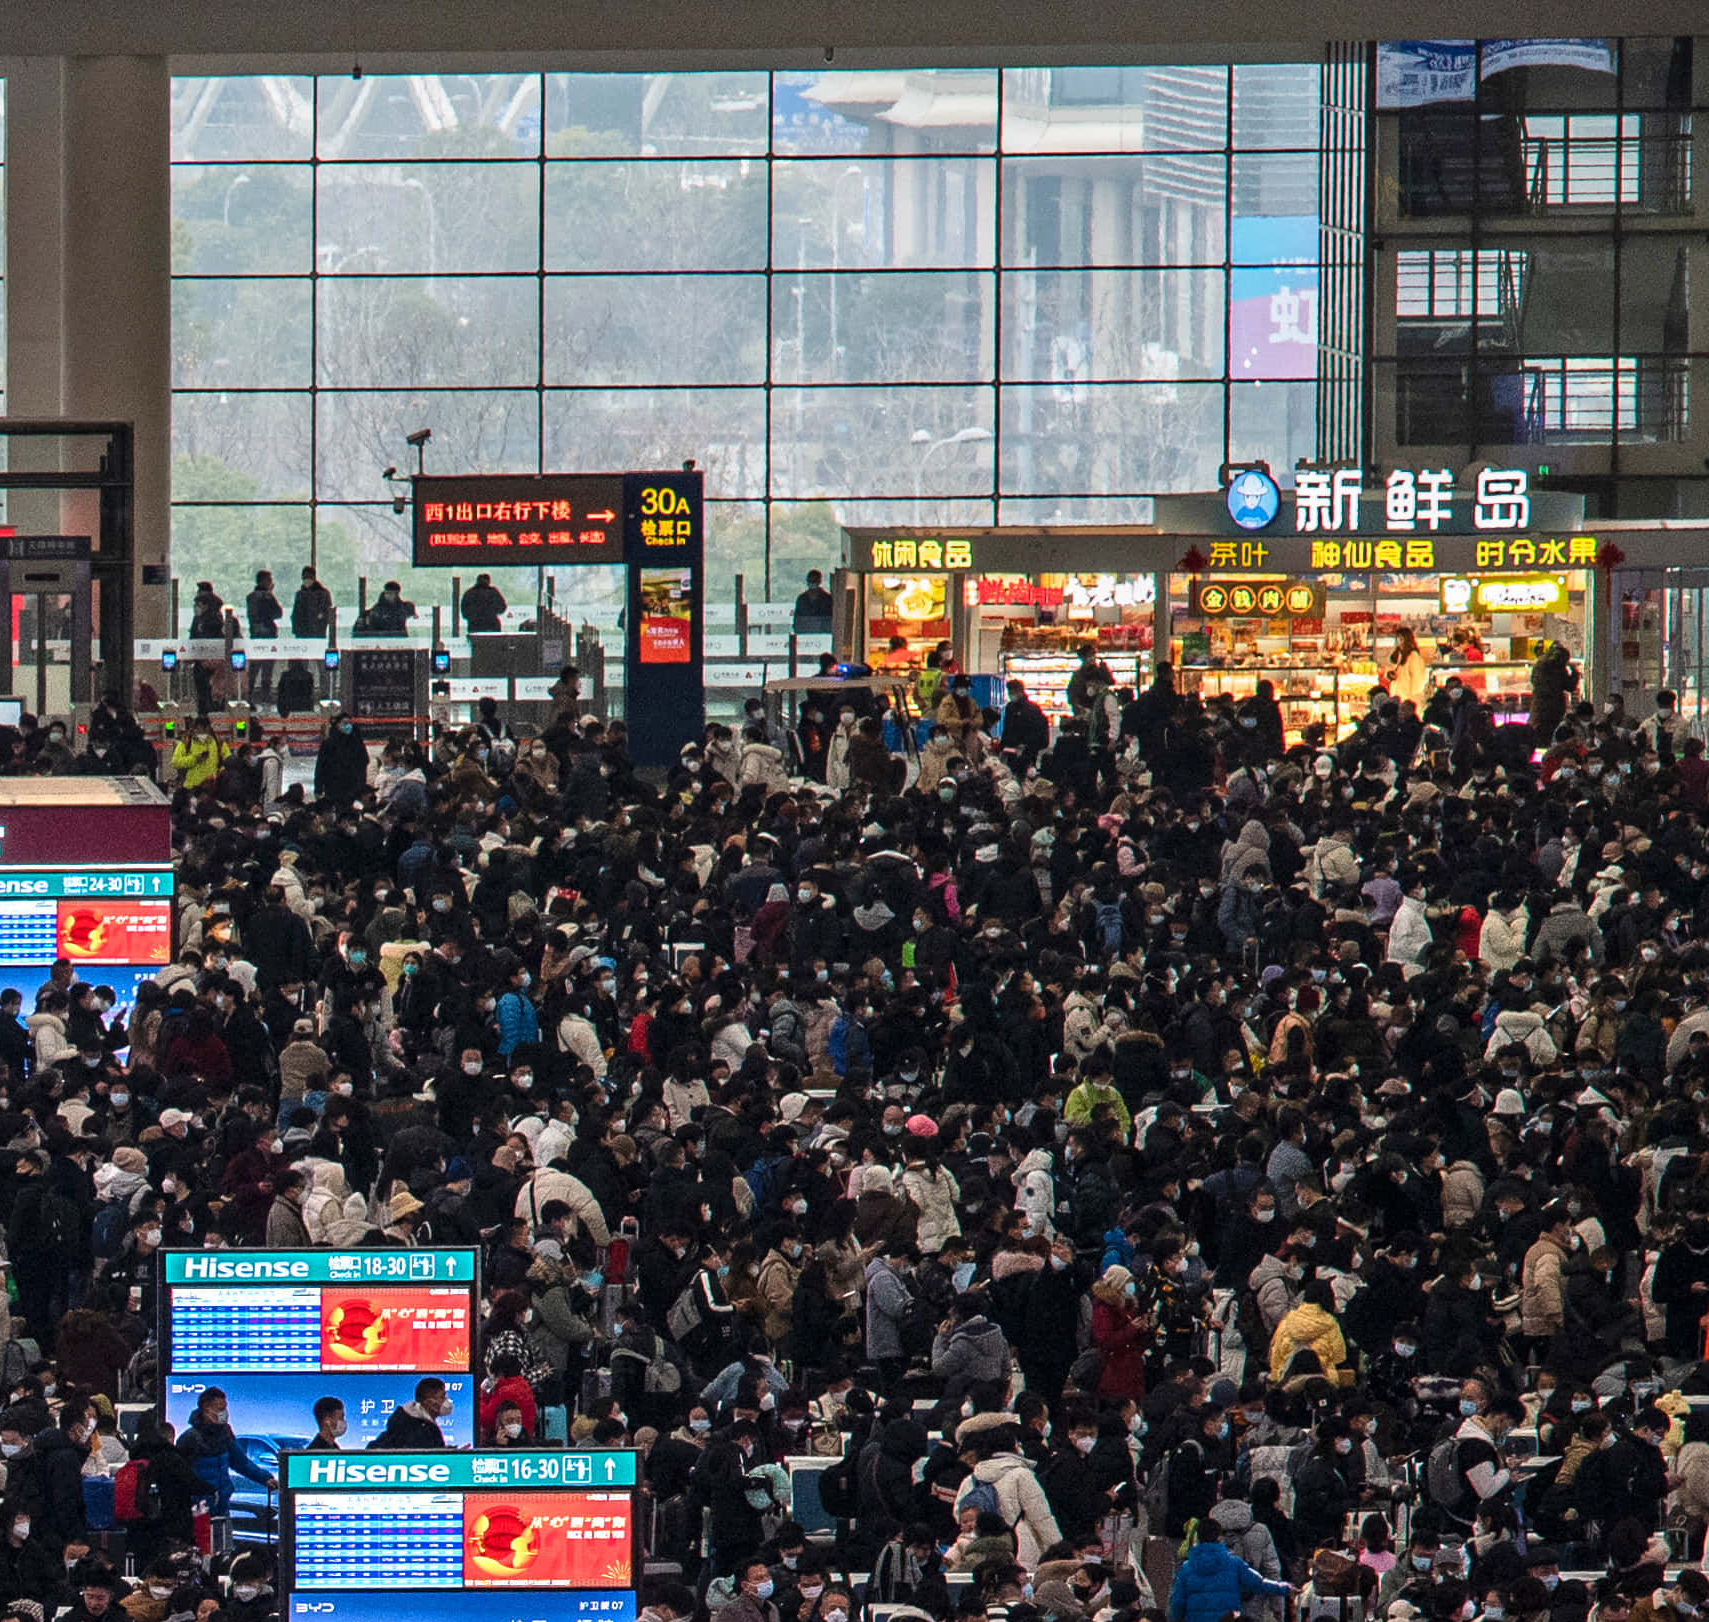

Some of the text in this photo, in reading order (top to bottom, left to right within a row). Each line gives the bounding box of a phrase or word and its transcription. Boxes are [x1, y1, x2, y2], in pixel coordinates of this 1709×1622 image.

[424, 501, 572, 523] 西1出口右行下楼
[641, 488, 691, 515] 30A
[1295, 468, 1530, 532] 新鲜岛
[640, 520, 691, 536] 检票口
[645, 536, 686, 545] Check in
[1476, 537, 1598, 567] 时令水果
[871, 540, 972, 568] 休闲食品
[1209, 542, 1269, 567] 茶叶
[1311, 540, 1435, 568] 神仙食品
[89, 877, 122, 892] 24-30
[184, 1257, 310, 1278] Hisense
[365, 1257, 406, 1275] 18-30
[309, 1460, 450, 1483] Hisense
[511, 1459, 558, 1479] 16-30
[473, 1474, 508, 1483] Check in
